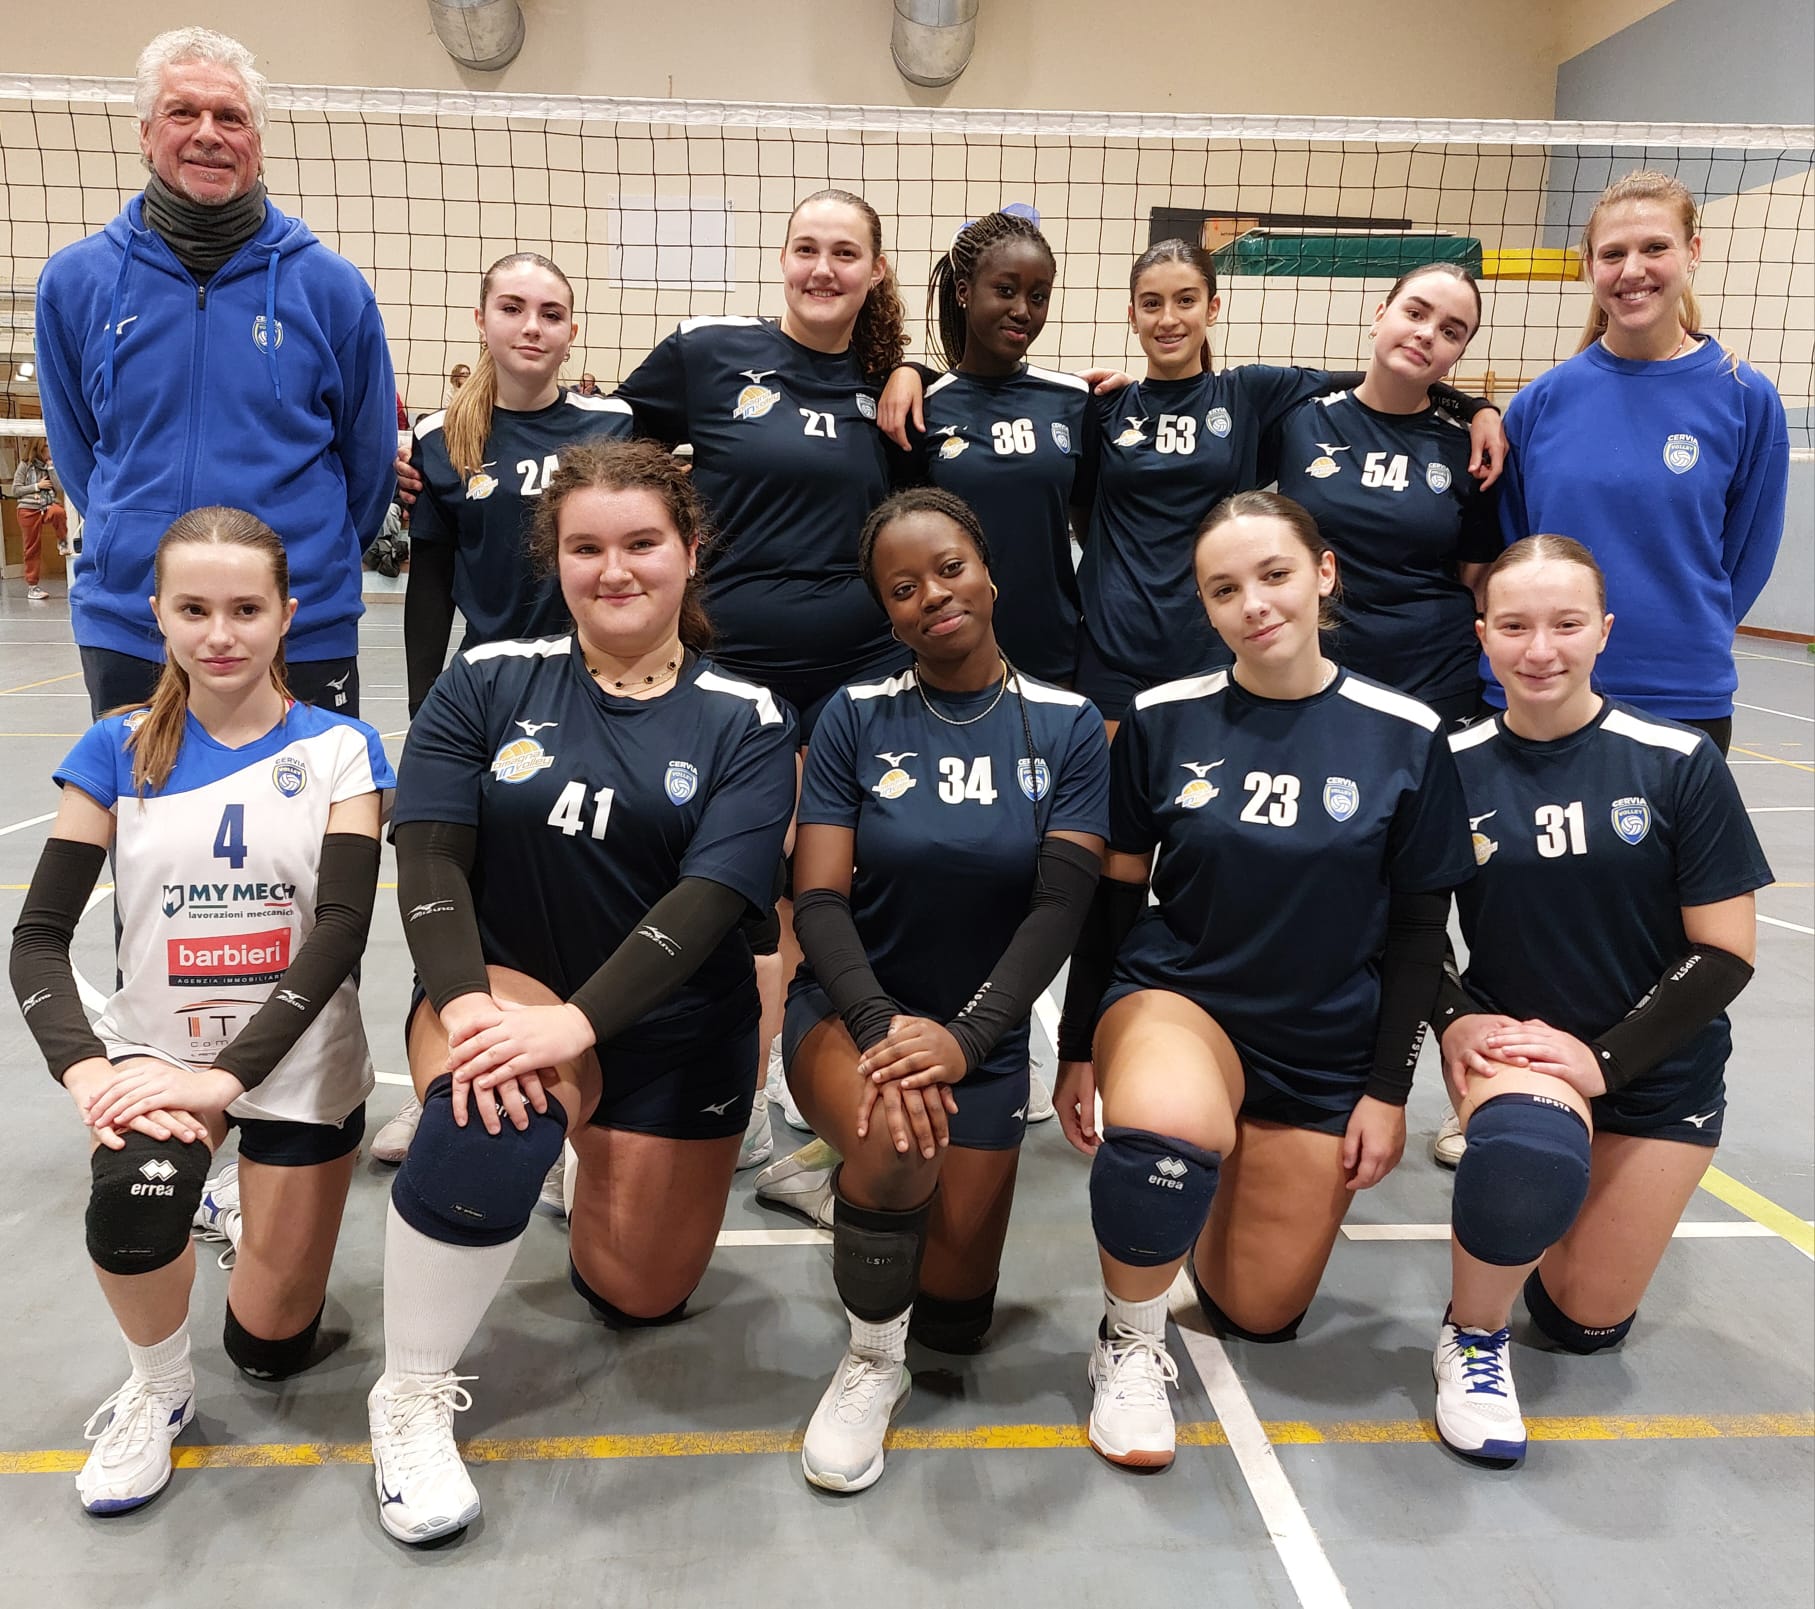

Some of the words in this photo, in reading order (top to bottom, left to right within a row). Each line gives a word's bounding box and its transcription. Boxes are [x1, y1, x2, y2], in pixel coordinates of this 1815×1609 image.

[799, 407, 837, 438] 21
[1155, 413, 1197, 455] 53
[991, 418, 1036, 455] 36
[1668, 434, 1697, 444] CERVIA
[1360, 451, 1410, 492] 54
[275, 757, 306, 768] CERVIA
[669, 761, 698, 775] CERVIA
[938, 755, 998, 805] 34
[1327, 776, 1357, 789] CERVIA
[547, 781, 615, 841] 41
[1239, 771, 1301, 828] 23
[1612, 797, 1647, 808] CERVIA
[1619, 809, 1643, 817] VOLLEY
[213, 804, 248, 869] 4
[1534, 801, 1588, 858] 31
[188, 884, 229, 902] MY
[232, 883, 296, 901] MECH
[188, 911, 244, 919] lavorazioni
[179, 941, 281, 967] barbieri
[1670, 954, 1702, 981] KIPSTA
[1405, 1020, 1429, 1067] KIPSTA
[1533, 1095, 1571, 1113] KIPSTA
